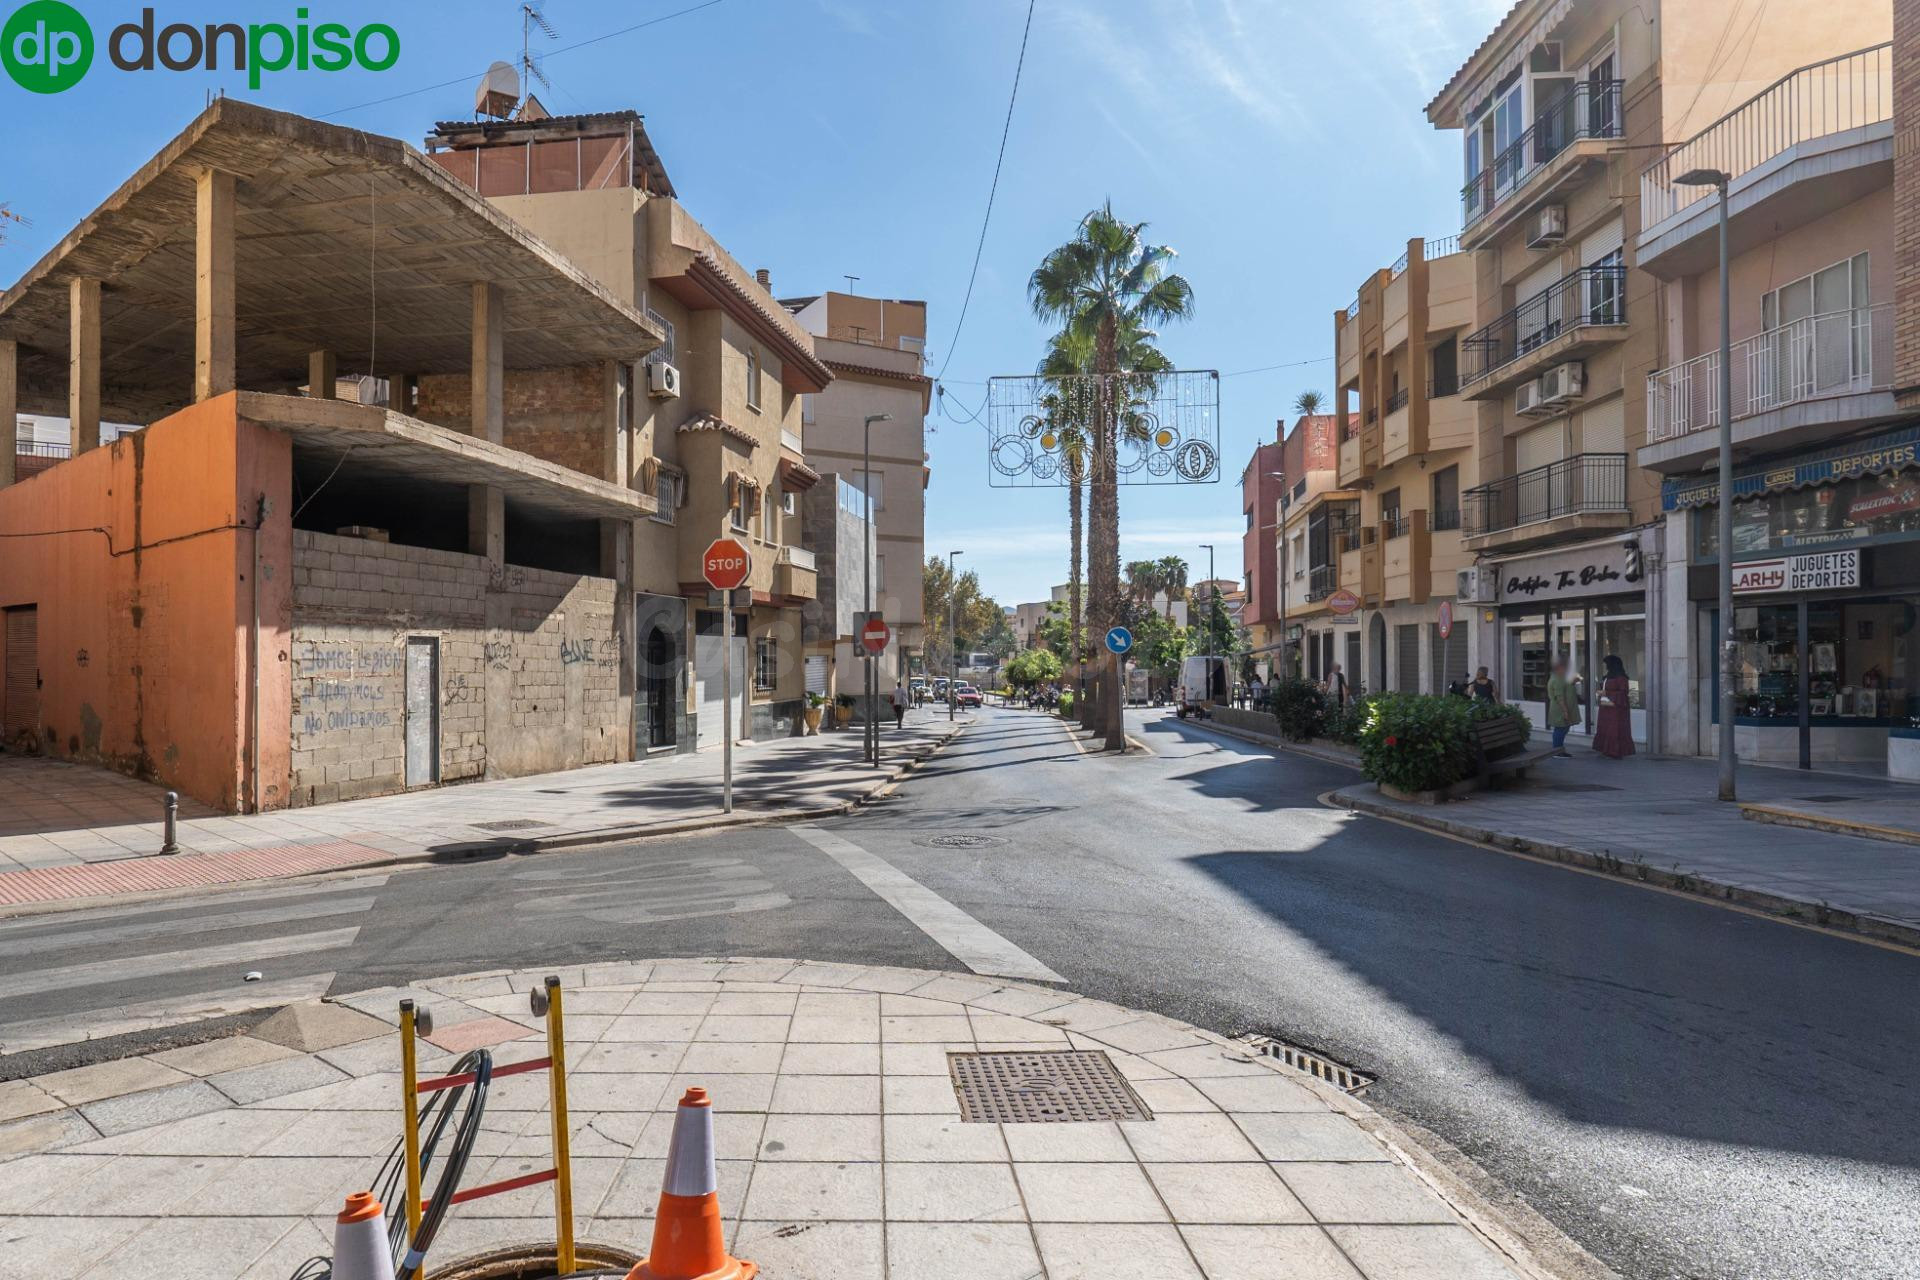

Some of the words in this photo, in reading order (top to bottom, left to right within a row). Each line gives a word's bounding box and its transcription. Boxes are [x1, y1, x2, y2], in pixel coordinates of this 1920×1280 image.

[1832, 446, 1915, 474] DEPORTES
[1676, 485, 1721, 505] JUGUETE
[708, 558, 743, 572] STOP
[1792, 553, 1856, 572] JUGUETES
[1792, 570, 1856, 589] DEPORTES
